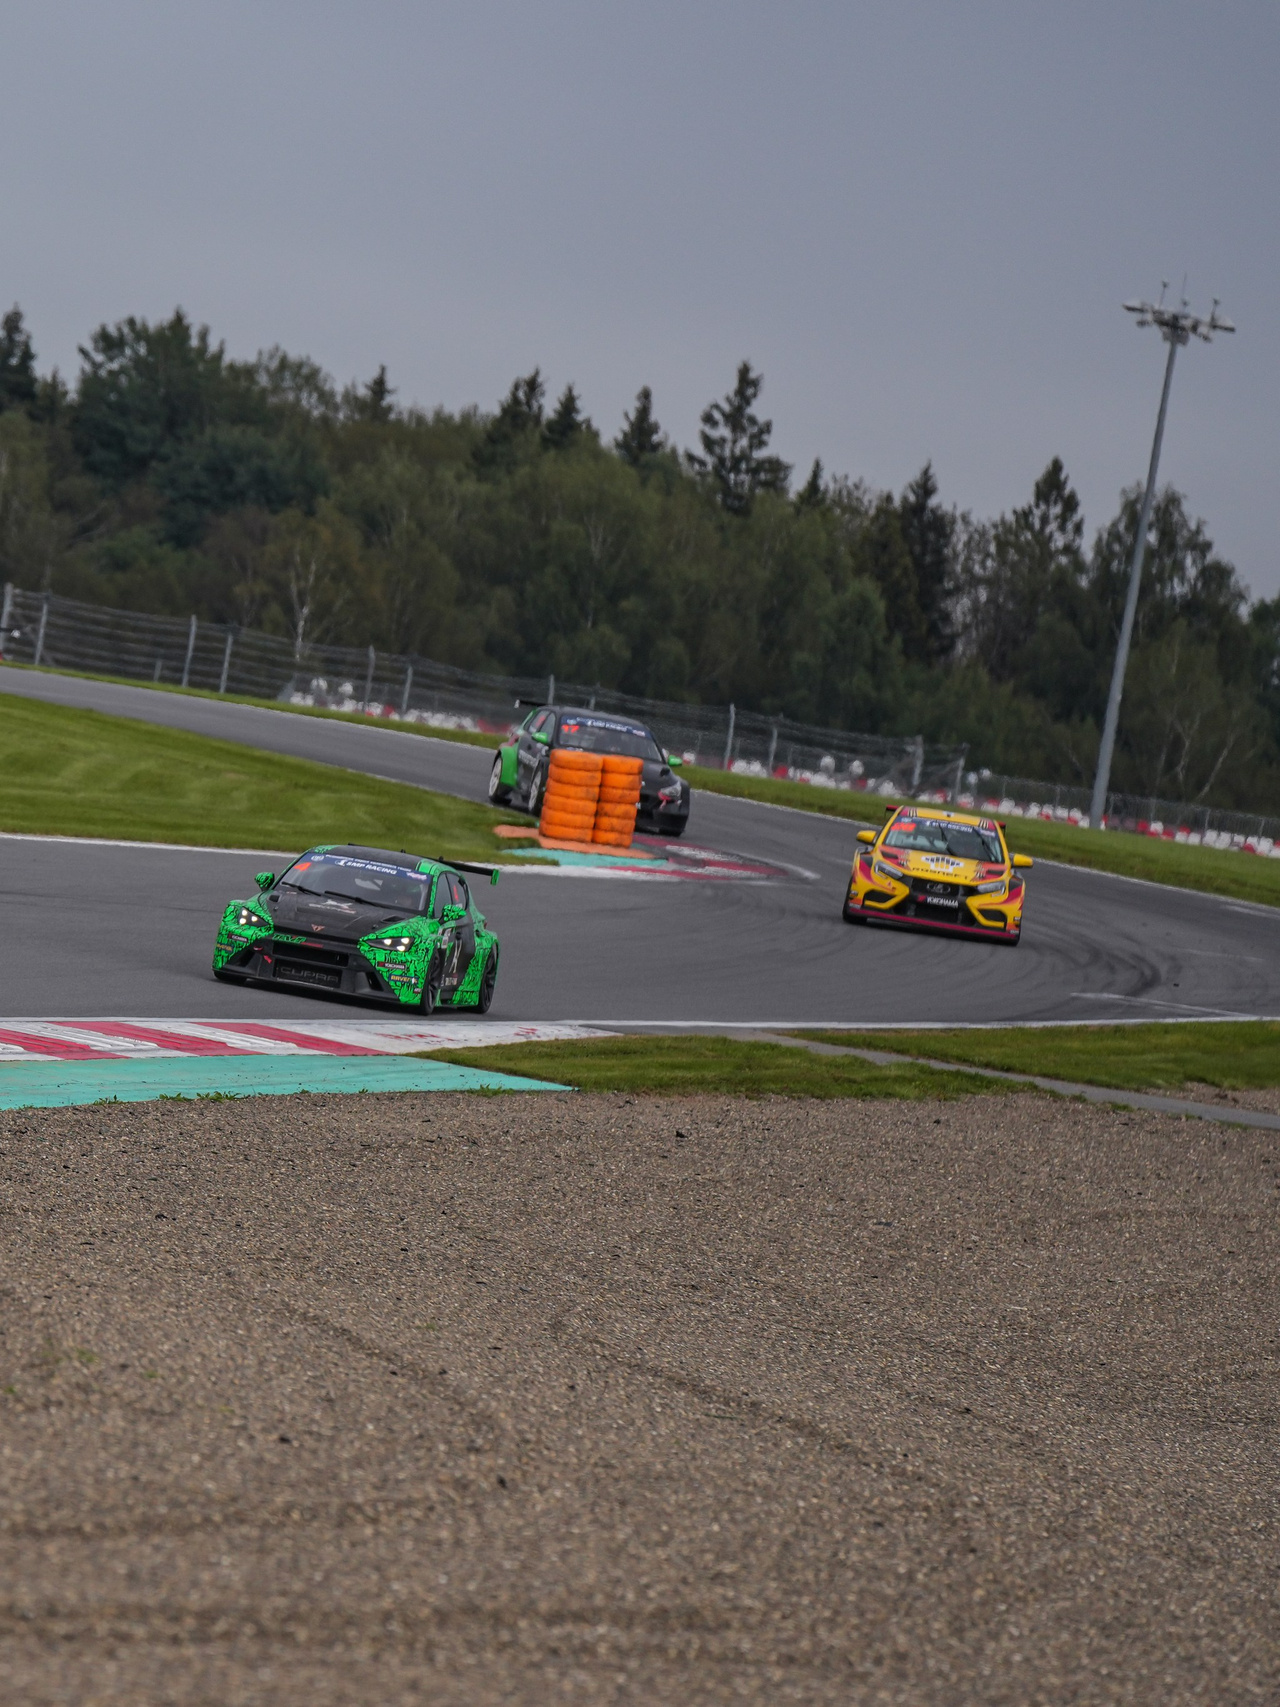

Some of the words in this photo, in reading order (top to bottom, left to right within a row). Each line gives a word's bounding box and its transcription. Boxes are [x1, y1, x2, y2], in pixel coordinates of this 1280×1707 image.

[294, 862, 312, 872] 4
[346, 861, 366, 869] SMP
[366, 864, 398, 875] RACING
[281, 966, 339, 983] CUPRA
